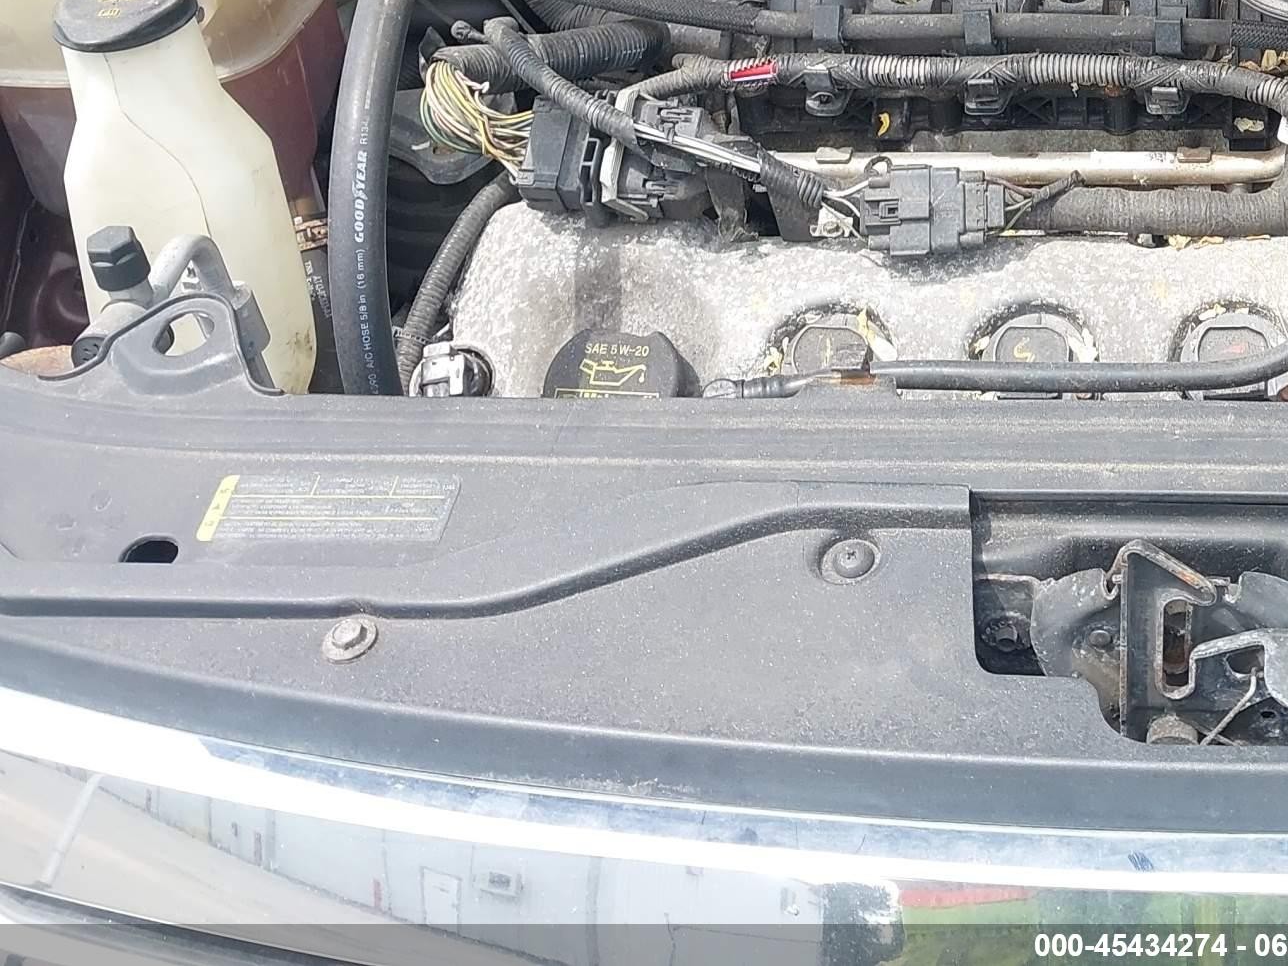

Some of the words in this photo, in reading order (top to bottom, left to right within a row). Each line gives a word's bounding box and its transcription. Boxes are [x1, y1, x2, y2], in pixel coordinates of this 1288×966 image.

[352, 150, 369, 243] GOODYEAR
[355, 249, 365, 271] mm)
[359, 305, 369, 320] 5/8
[361, 323, 372, 350] HOSE
[585, 343, 607, 355] SAE
[364, 352, 375, 369] A/C
